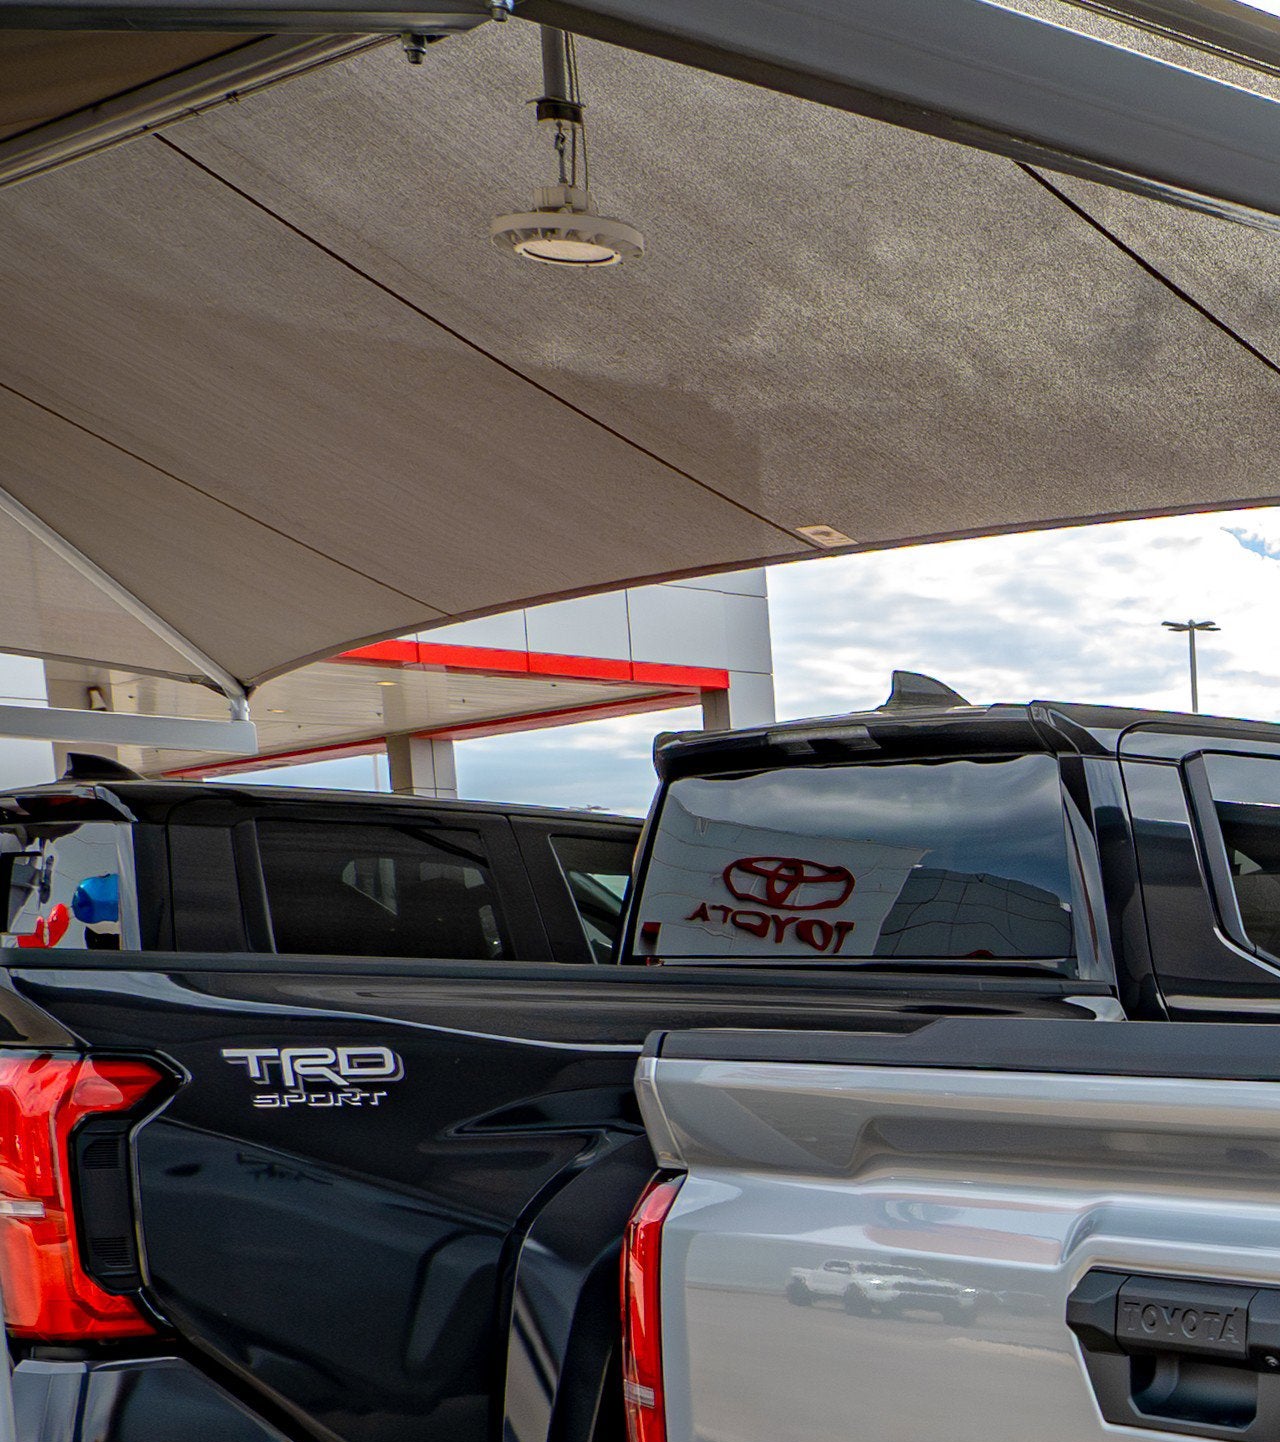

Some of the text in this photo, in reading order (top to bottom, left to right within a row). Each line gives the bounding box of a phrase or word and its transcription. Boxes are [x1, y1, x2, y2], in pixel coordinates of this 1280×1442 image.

[221, 1046, 405, 1093] TRD
[253, 1090, 388, 1109] SPORT
[1123, 1300, 1240, 1345] TOYOTA
